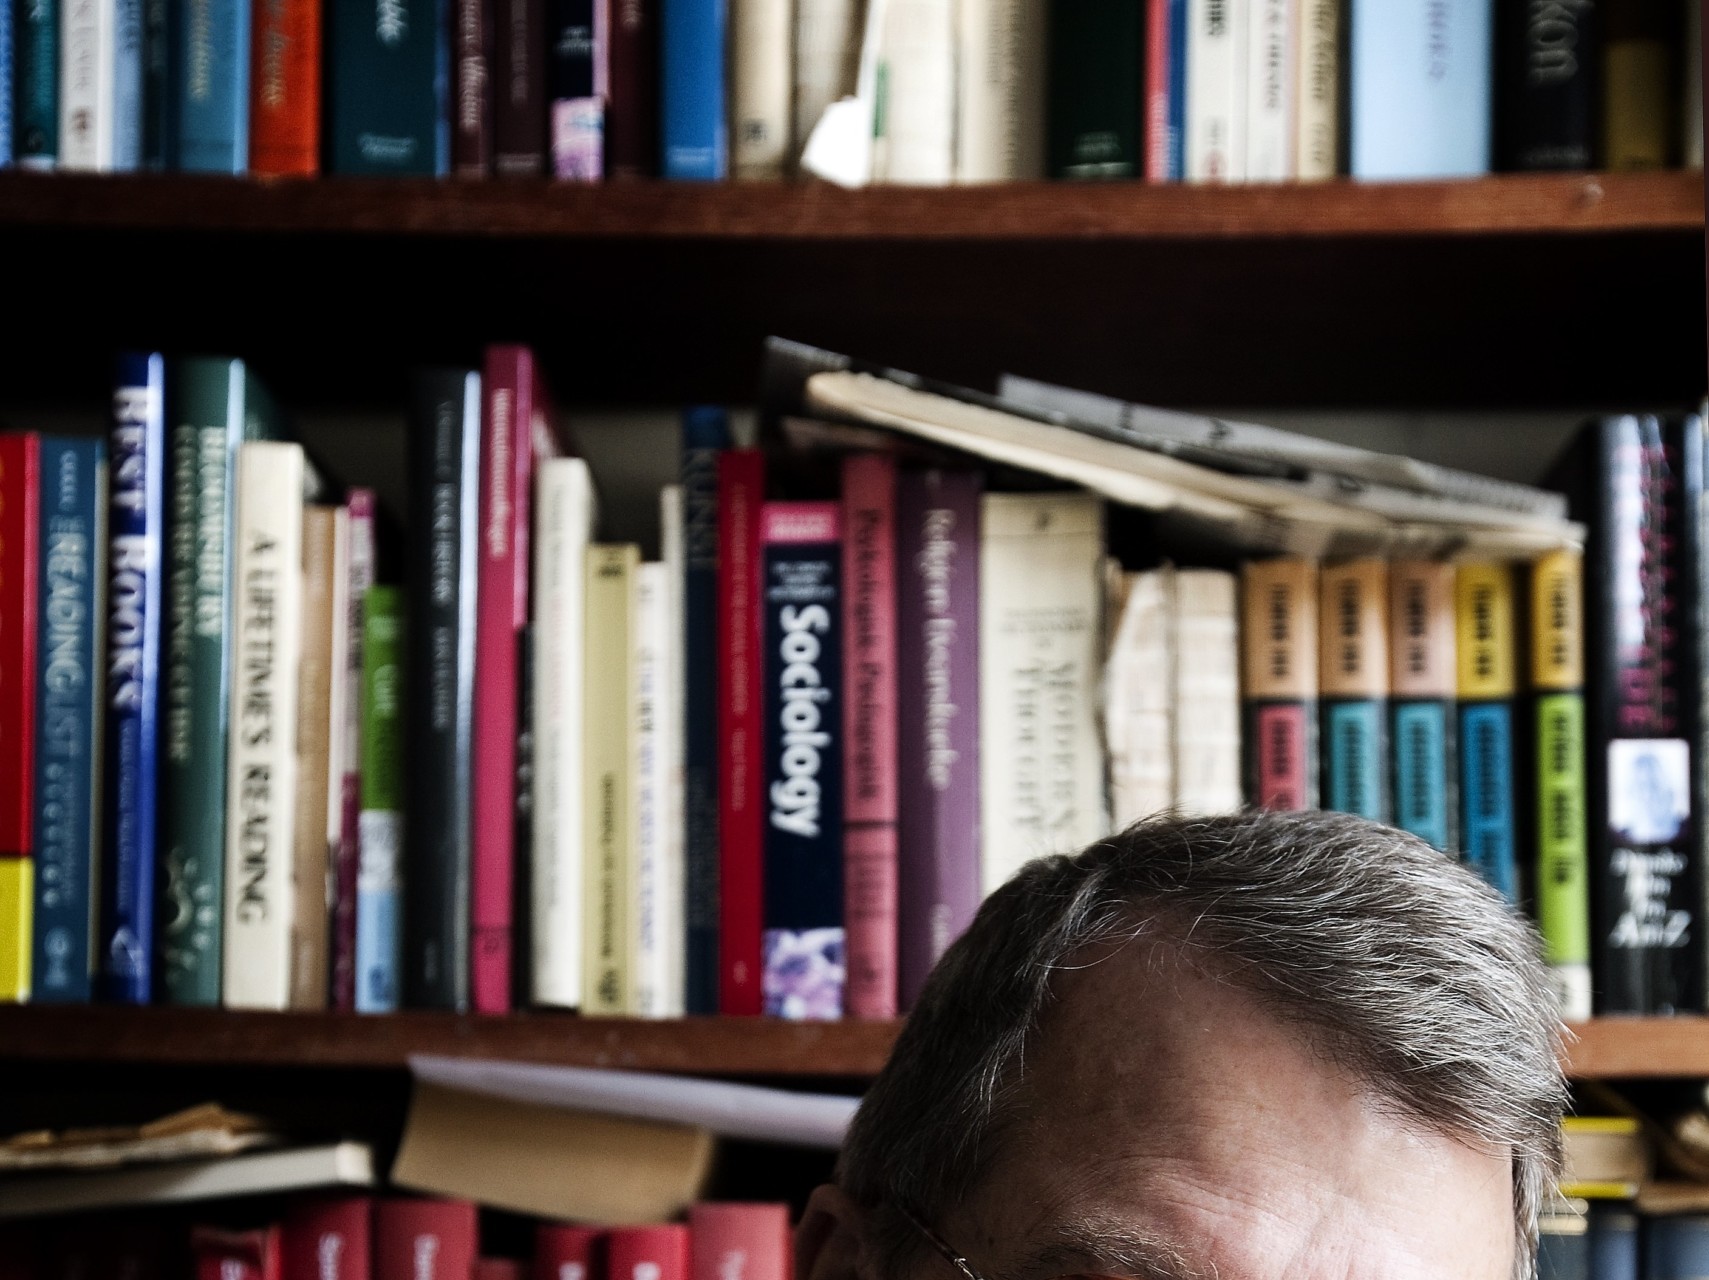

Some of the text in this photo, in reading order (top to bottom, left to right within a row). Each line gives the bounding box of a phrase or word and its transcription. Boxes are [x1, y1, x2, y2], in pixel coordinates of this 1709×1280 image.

[111, 386, 158, 510] BEST
[110, 534, 157, 710] BOOKS
[245, 533, 277, 554] A
[769, 604, 831, 837] Sociology
[236, 763, 273, 926] READING
